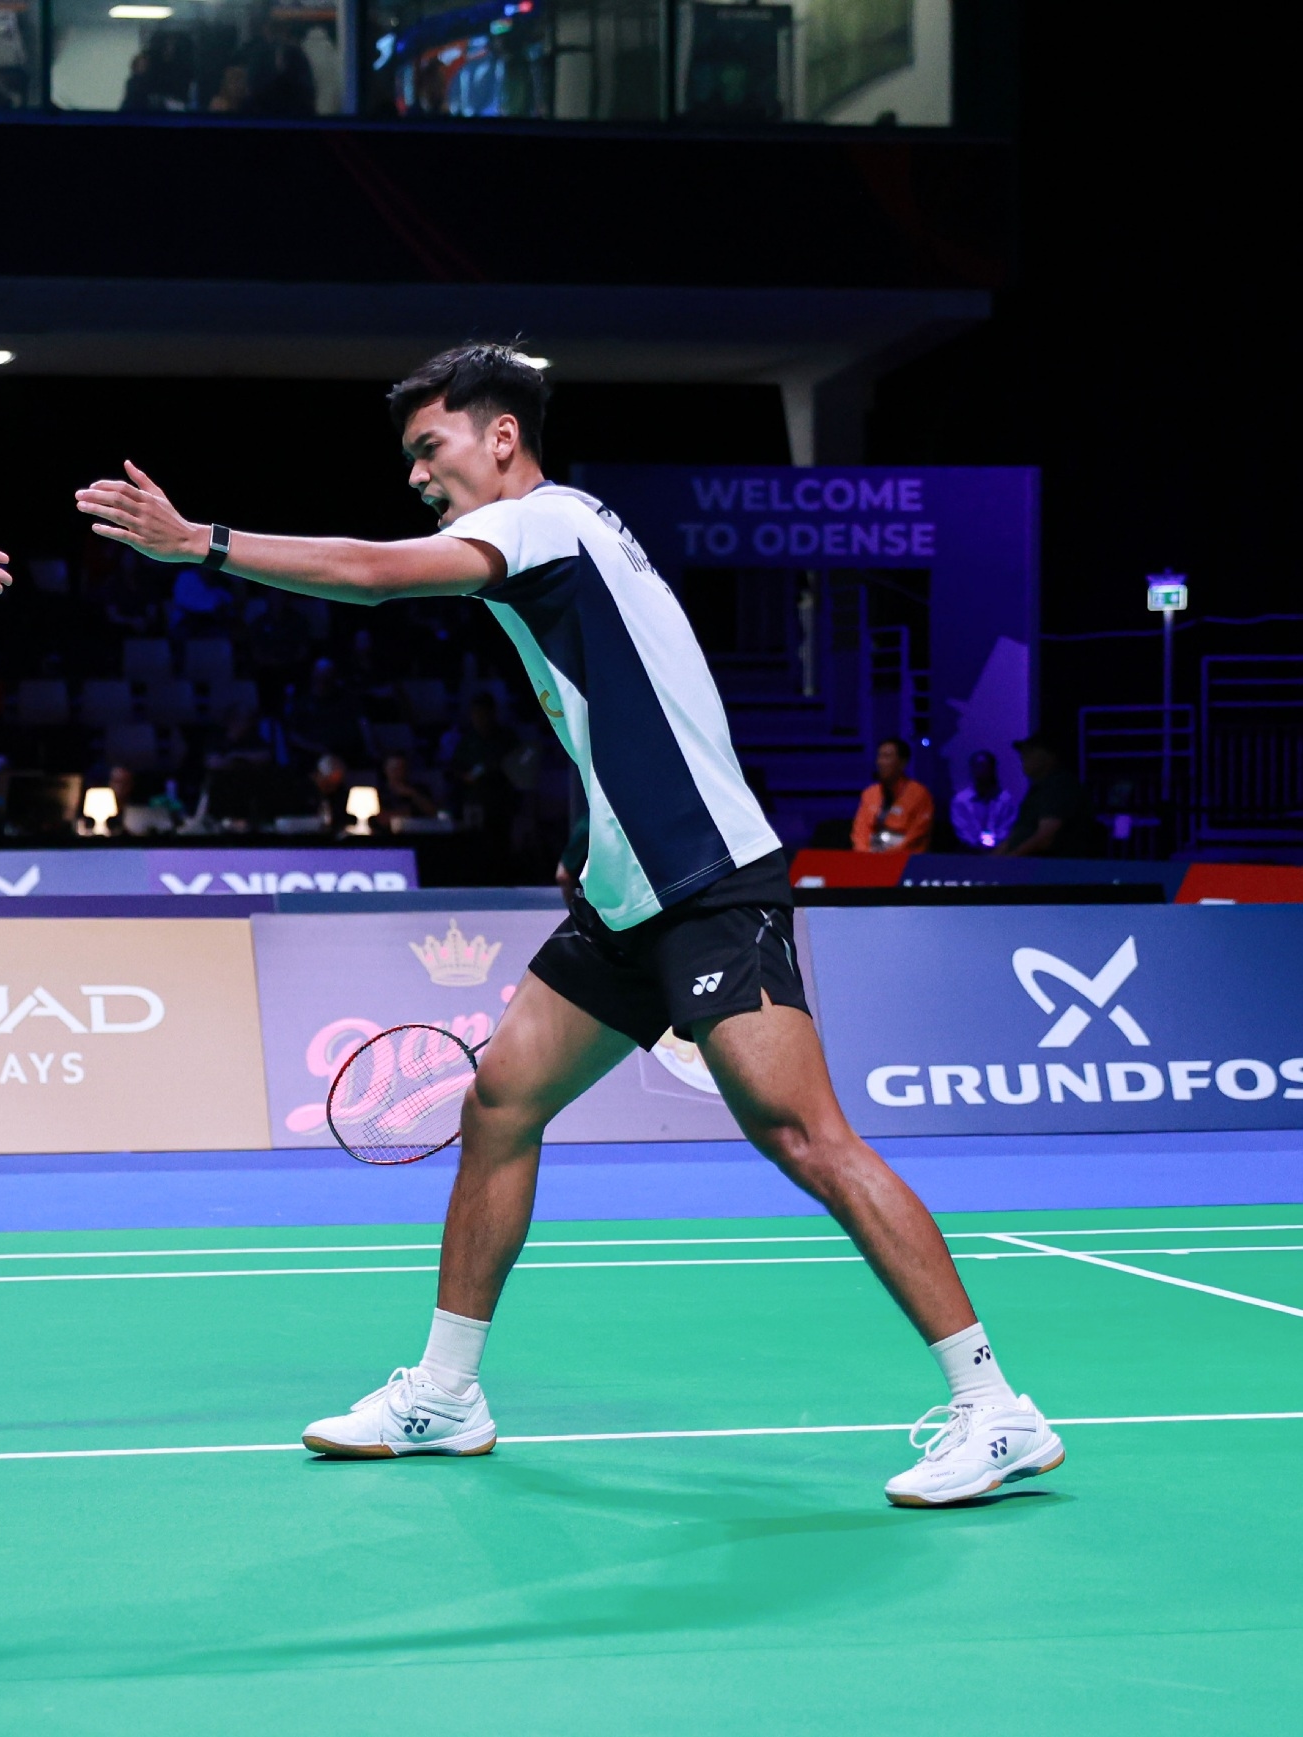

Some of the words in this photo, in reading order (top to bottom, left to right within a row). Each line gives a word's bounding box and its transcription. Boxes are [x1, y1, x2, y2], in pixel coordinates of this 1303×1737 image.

[691, 478, 924, 512] WELCOME
[677, 523, 739, 557] TO
[753, 523, 936, 557] ODENSE
